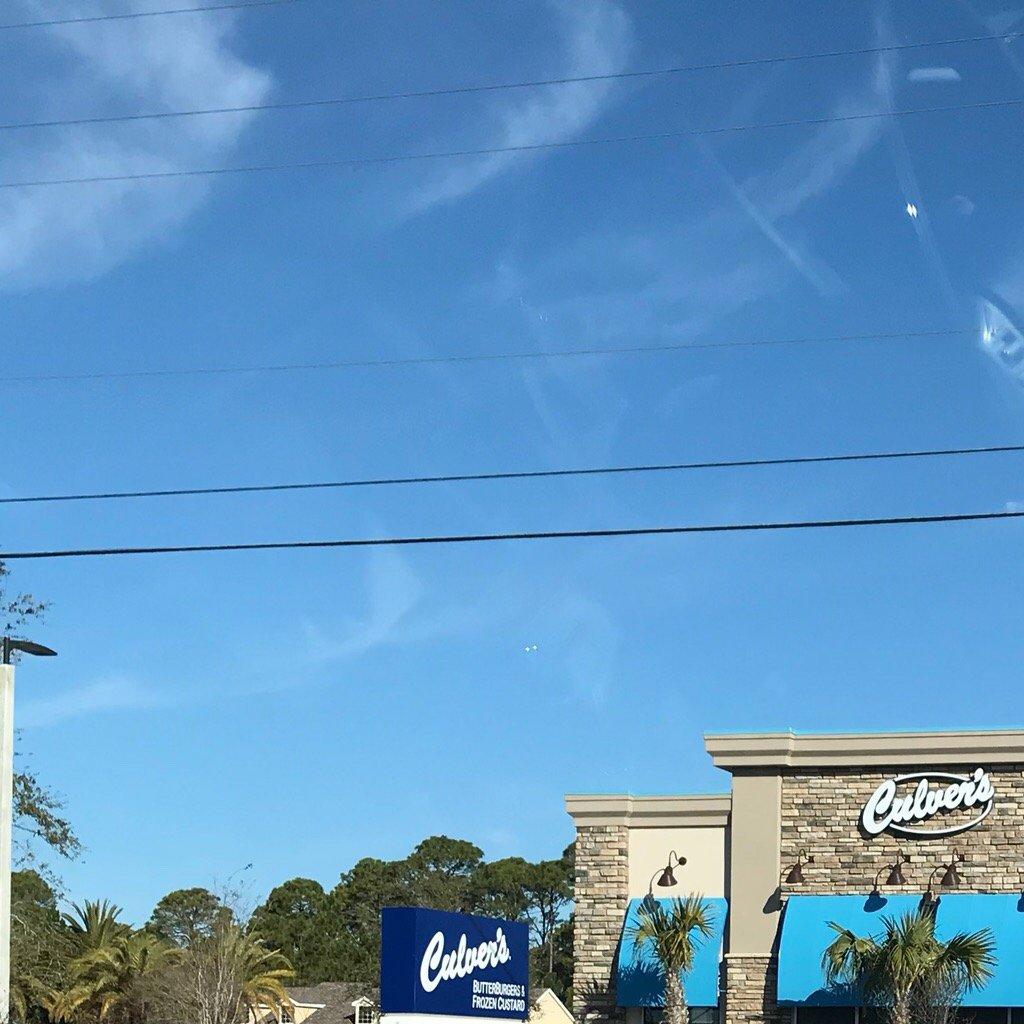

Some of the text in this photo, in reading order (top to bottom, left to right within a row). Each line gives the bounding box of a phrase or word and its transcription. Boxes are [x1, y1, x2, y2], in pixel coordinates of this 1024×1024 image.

[862, 767, 995, 834] Culver's
[420, 927, 510, 993] Culver's
[472, 994, 526, 1012] FROZEN CUSTARD
